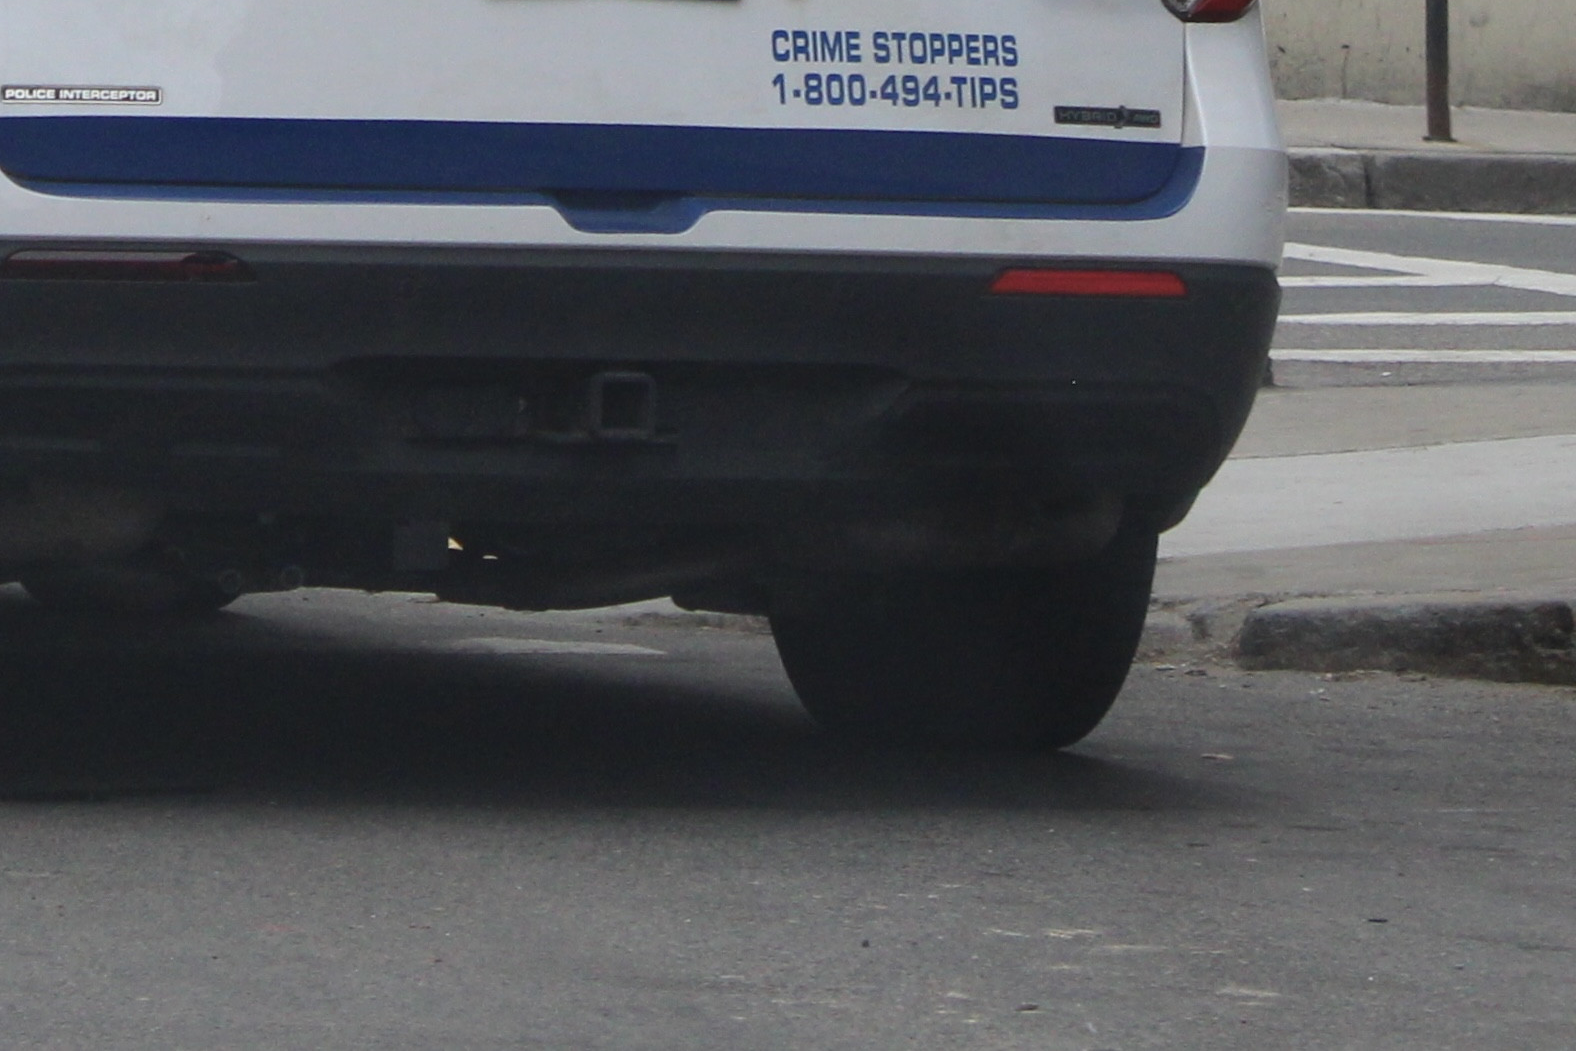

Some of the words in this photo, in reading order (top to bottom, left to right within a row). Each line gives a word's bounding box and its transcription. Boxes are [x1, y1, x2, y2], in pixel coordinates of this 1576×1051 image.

[772, 30, 862, 63] CRIME
[873, 31, 1019, 67] STOPPERS
[5, 89, 56, 99] POLICE
[59, 90, 156, 101] INTERCEPTOR
[772, 73, 1020, 110] 1-800-494-TIPS
